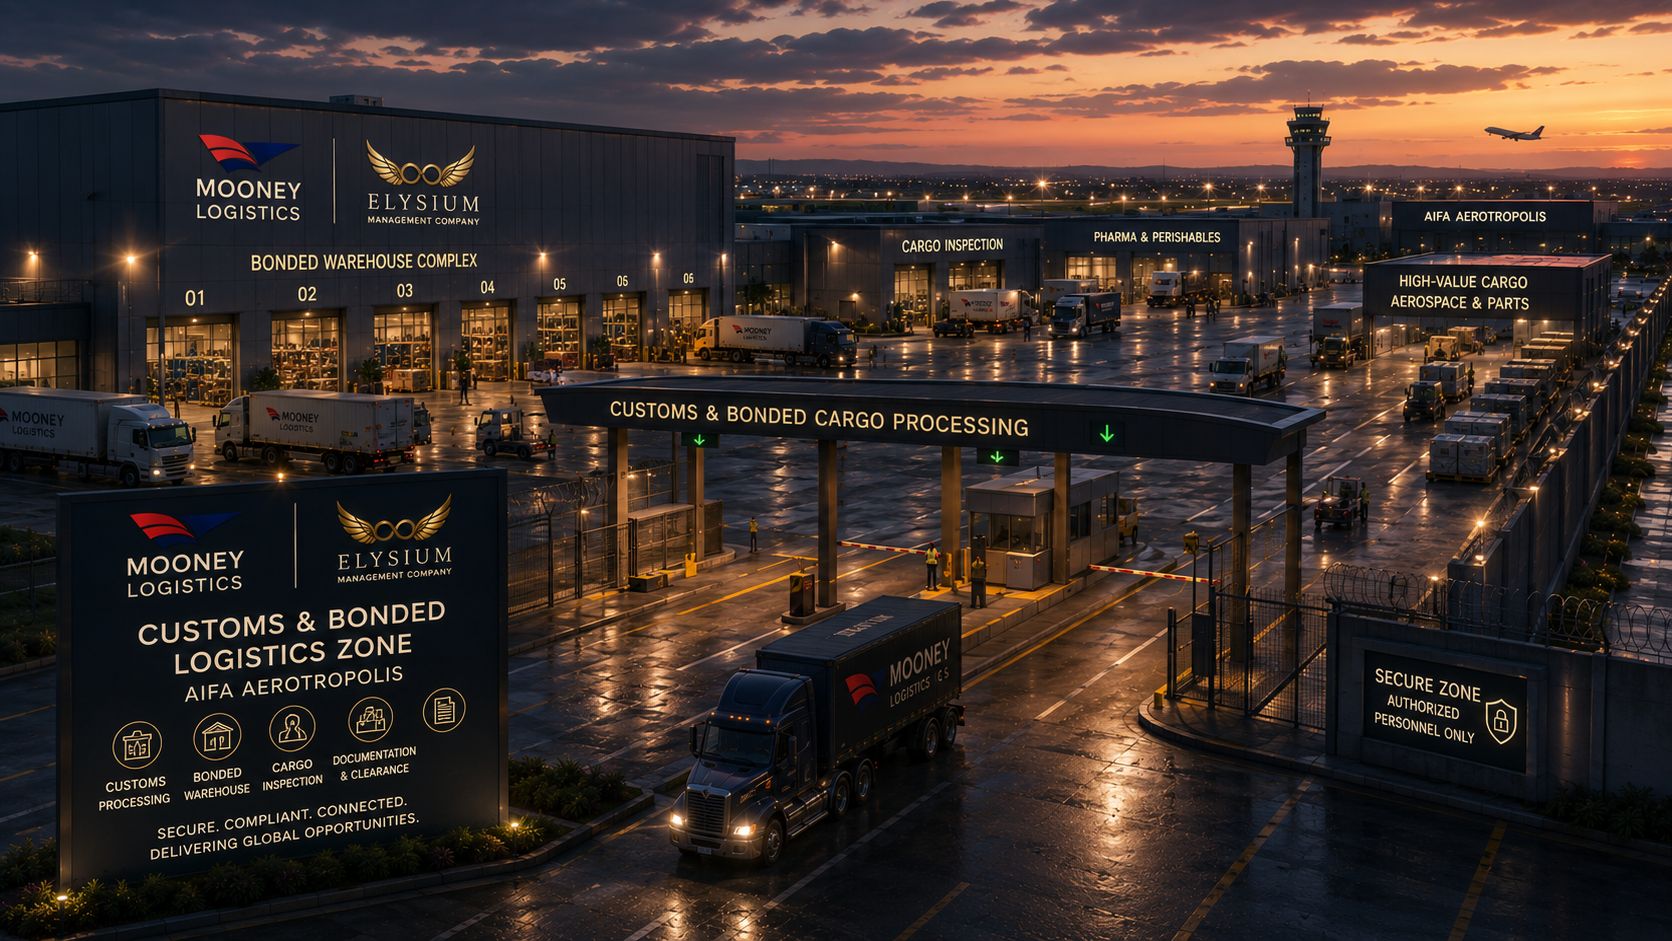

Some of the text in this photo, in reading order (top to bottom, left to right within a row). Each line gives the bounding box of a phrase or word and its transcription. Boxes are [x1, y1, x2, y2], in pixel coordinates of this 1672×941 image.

[197, 178, 301, 200] MOONEY
[368, 193, 479, 212] ELYSIUM
[197, 204, 300, 221] LOGISTICS
[368, 216, 480, 225] MANAGEMENT COMPANY
[1424, 211, 1546, 222] AIFA AEROTROPOLIS
[902, 238, 1003, 253] CARGO INSPECTION
[1094, 231, 1221, 243] PHARMA & PERISHABLES
[251, 253, 477, 271] BONDED WAREHOUSE COMPLEX
[397, 283, 413, 298] 03
[481, 280, 495, 294] 04
[553, 278, 566, 290] 05
[1400, 275, 1528, 289] HIGH-VALUE CARGO
[185, 290, 204, 306] 01
[298, 286, 317, 302] 02
[1391, 295, 1529, 310] AEROSPACE & PARTS
[12, 411, 65, 427] MOONEY
[281, 411, 319, 423] MOONEY
[610, 401, 1028, 436] CUSTOMS & BONDED CARGO PROCESSING
[128, 550, 244, 576] MOONEY
[338, 547, 452, 571] ELYSIUM
[337, 568, 452, 583] MANAGEMENT COMPANY
[128, 575, 242, 598] LOGISTICS
[138, 601, 445, 645] CUSTOMS & BONDED
[175, 633, 412, 675] LOGISTICS ZONE
[890, 638, 950, 687] MOONEY
[185, 666, 403, 702] AIFA AEROTROPOLIS
[890, 676, 930, 708] LOGISTICS
[1375, 668, 1481, 703] SECURE ZONE
[1387, 694, 1459, 720] AUTHORIZED
[1375, 712, 1475, 744] PERSONNEL ONLY
[333, 746, 416, 765] DOCUMENTATION
[193, 767, 242, 782] BONDED
[272, 759, 313, 773] CARGO
[340, 763, 409, 781] & CLEARANCE
[105, 776, 166, 793] CUSTOMS
[263, 774, 323, 791] INSPECTION
[184, 783, 250, 800] WAREHOUSE
[99, 793, 170, 811] PROCESSING
[158, 796, 407, 839] SECURE. COMPLIANT. CONNECTED.
[150, 813, 419, 860] DELIVERING GLOBAL OPPORTUNITIES.
